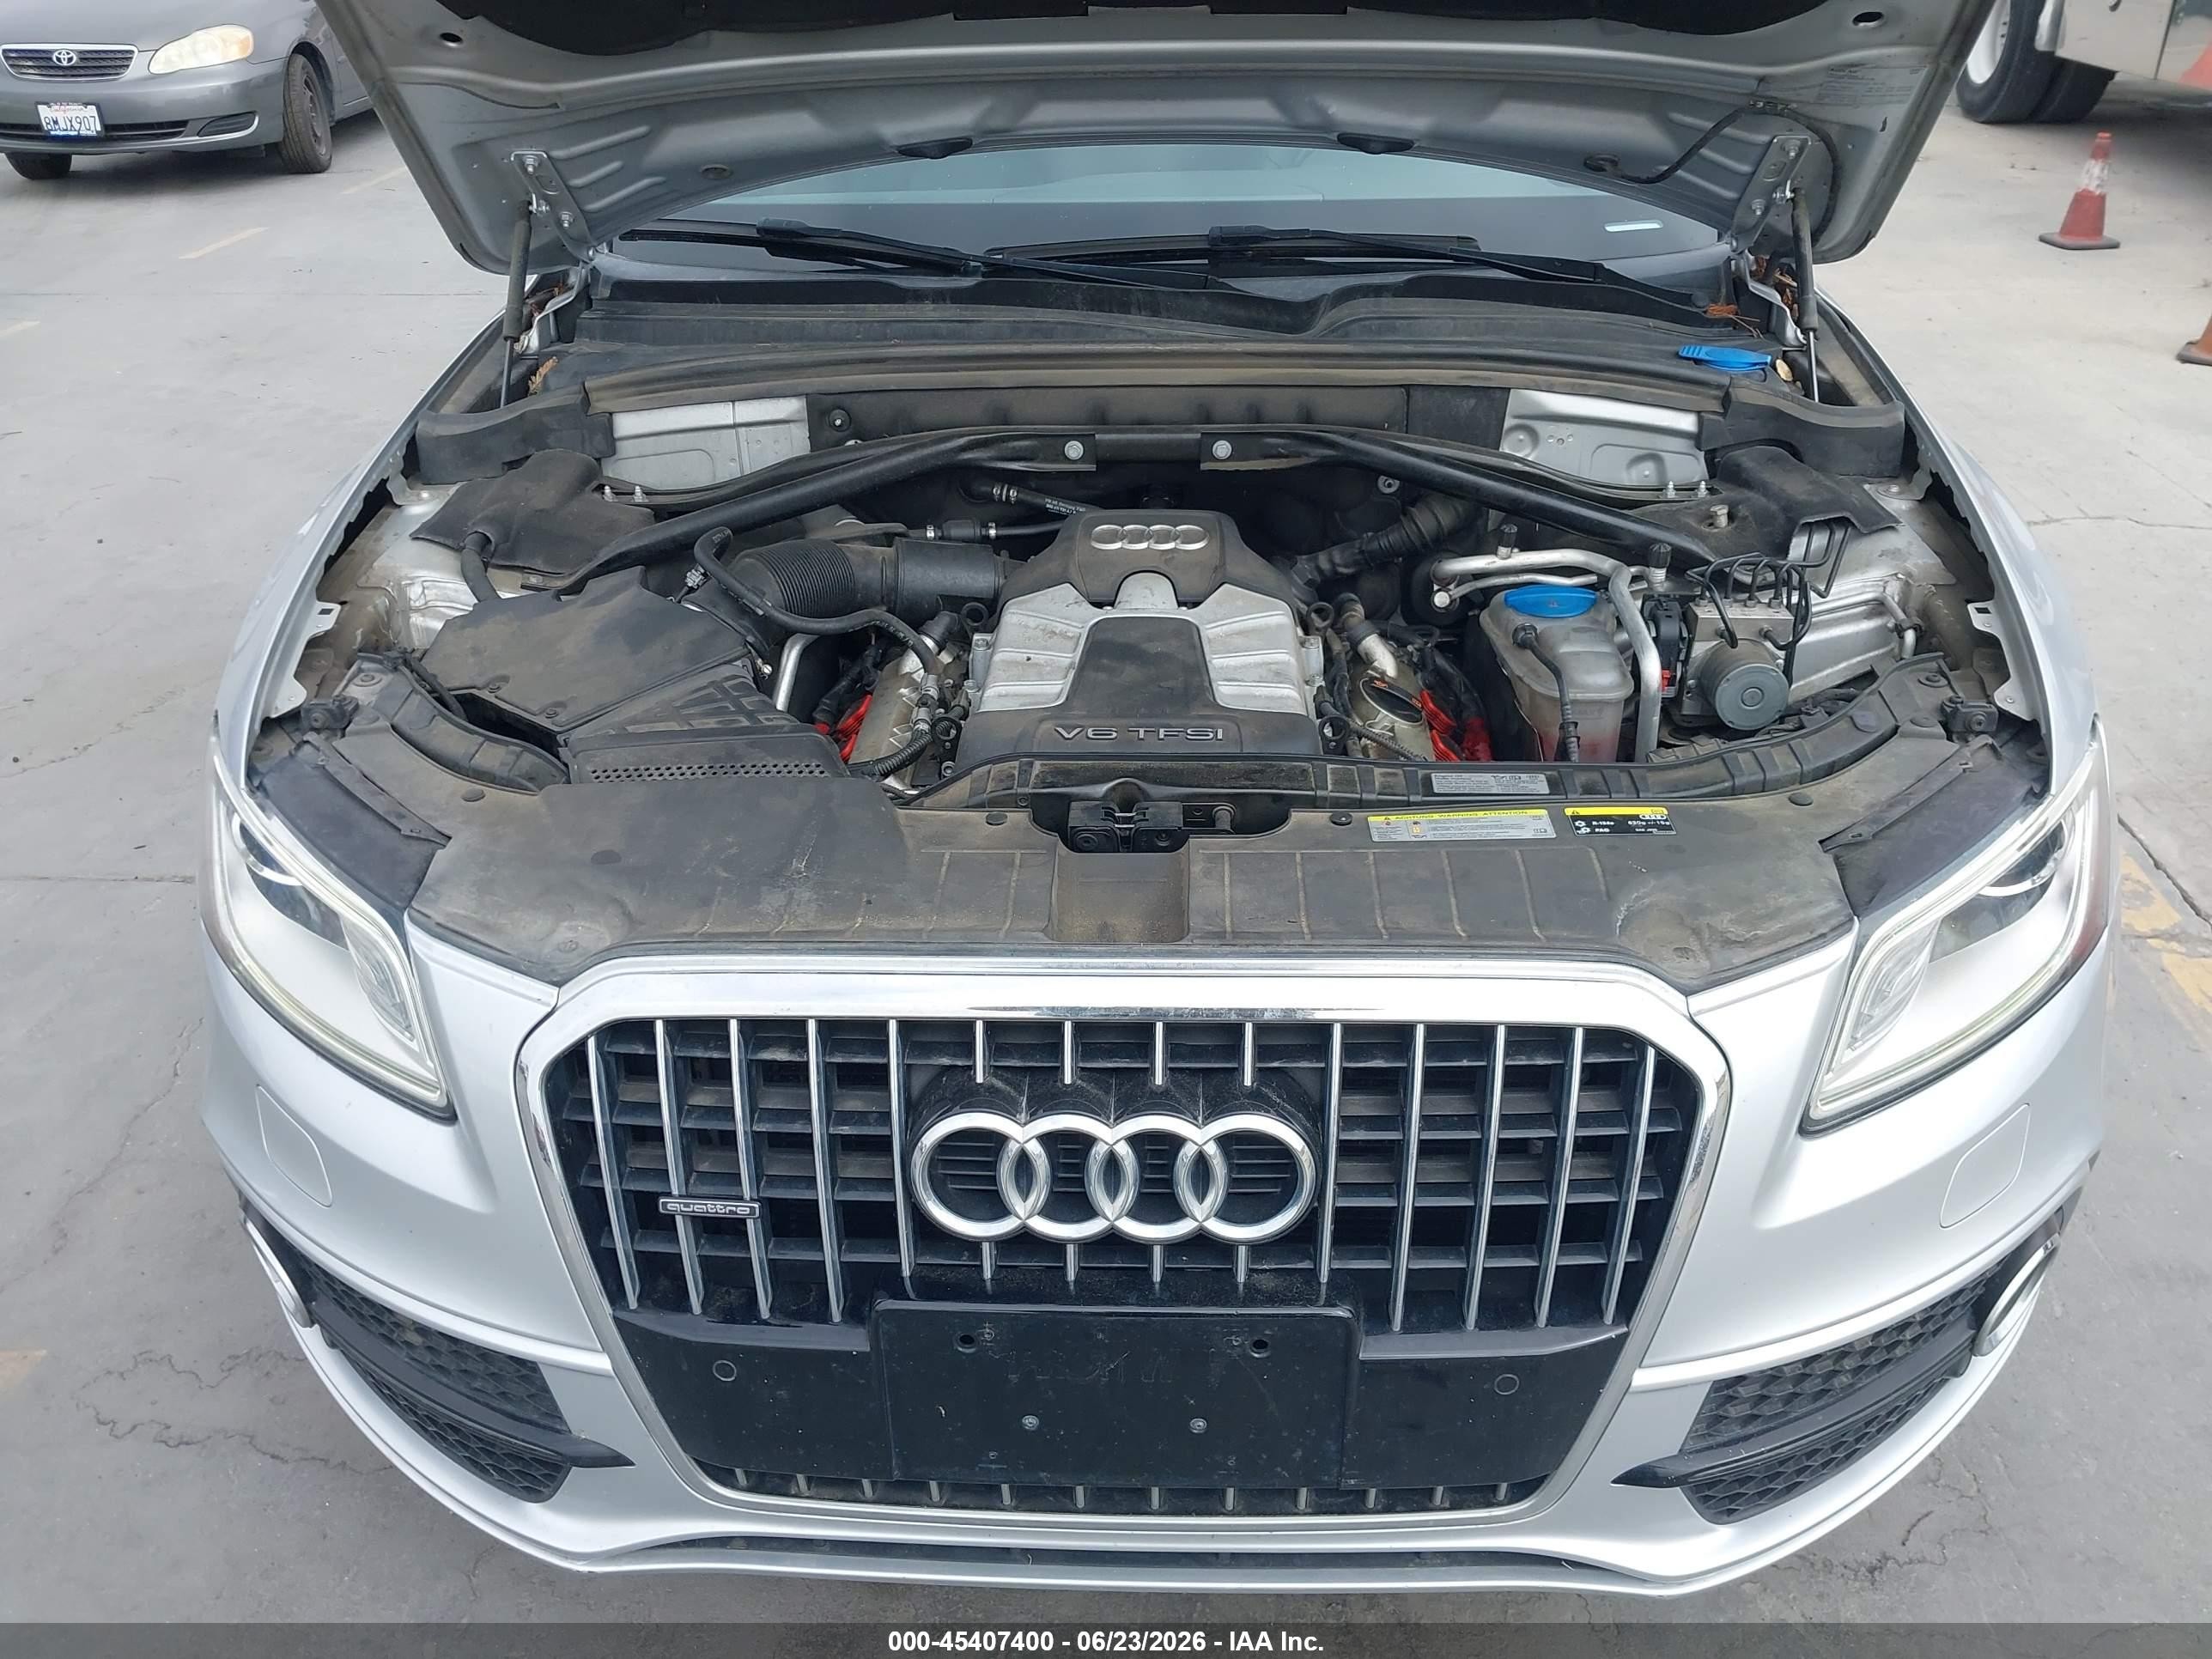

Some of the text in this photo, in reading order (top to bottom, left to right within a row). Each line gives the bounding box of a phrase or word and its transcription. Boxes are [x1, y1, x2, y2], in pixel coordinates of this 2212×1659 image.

[44, 116, 96, 131] 8MJX907
[1054, 726, 1224, 741] V6 TFSI
[666, 1203, 750, 1214] quattro
